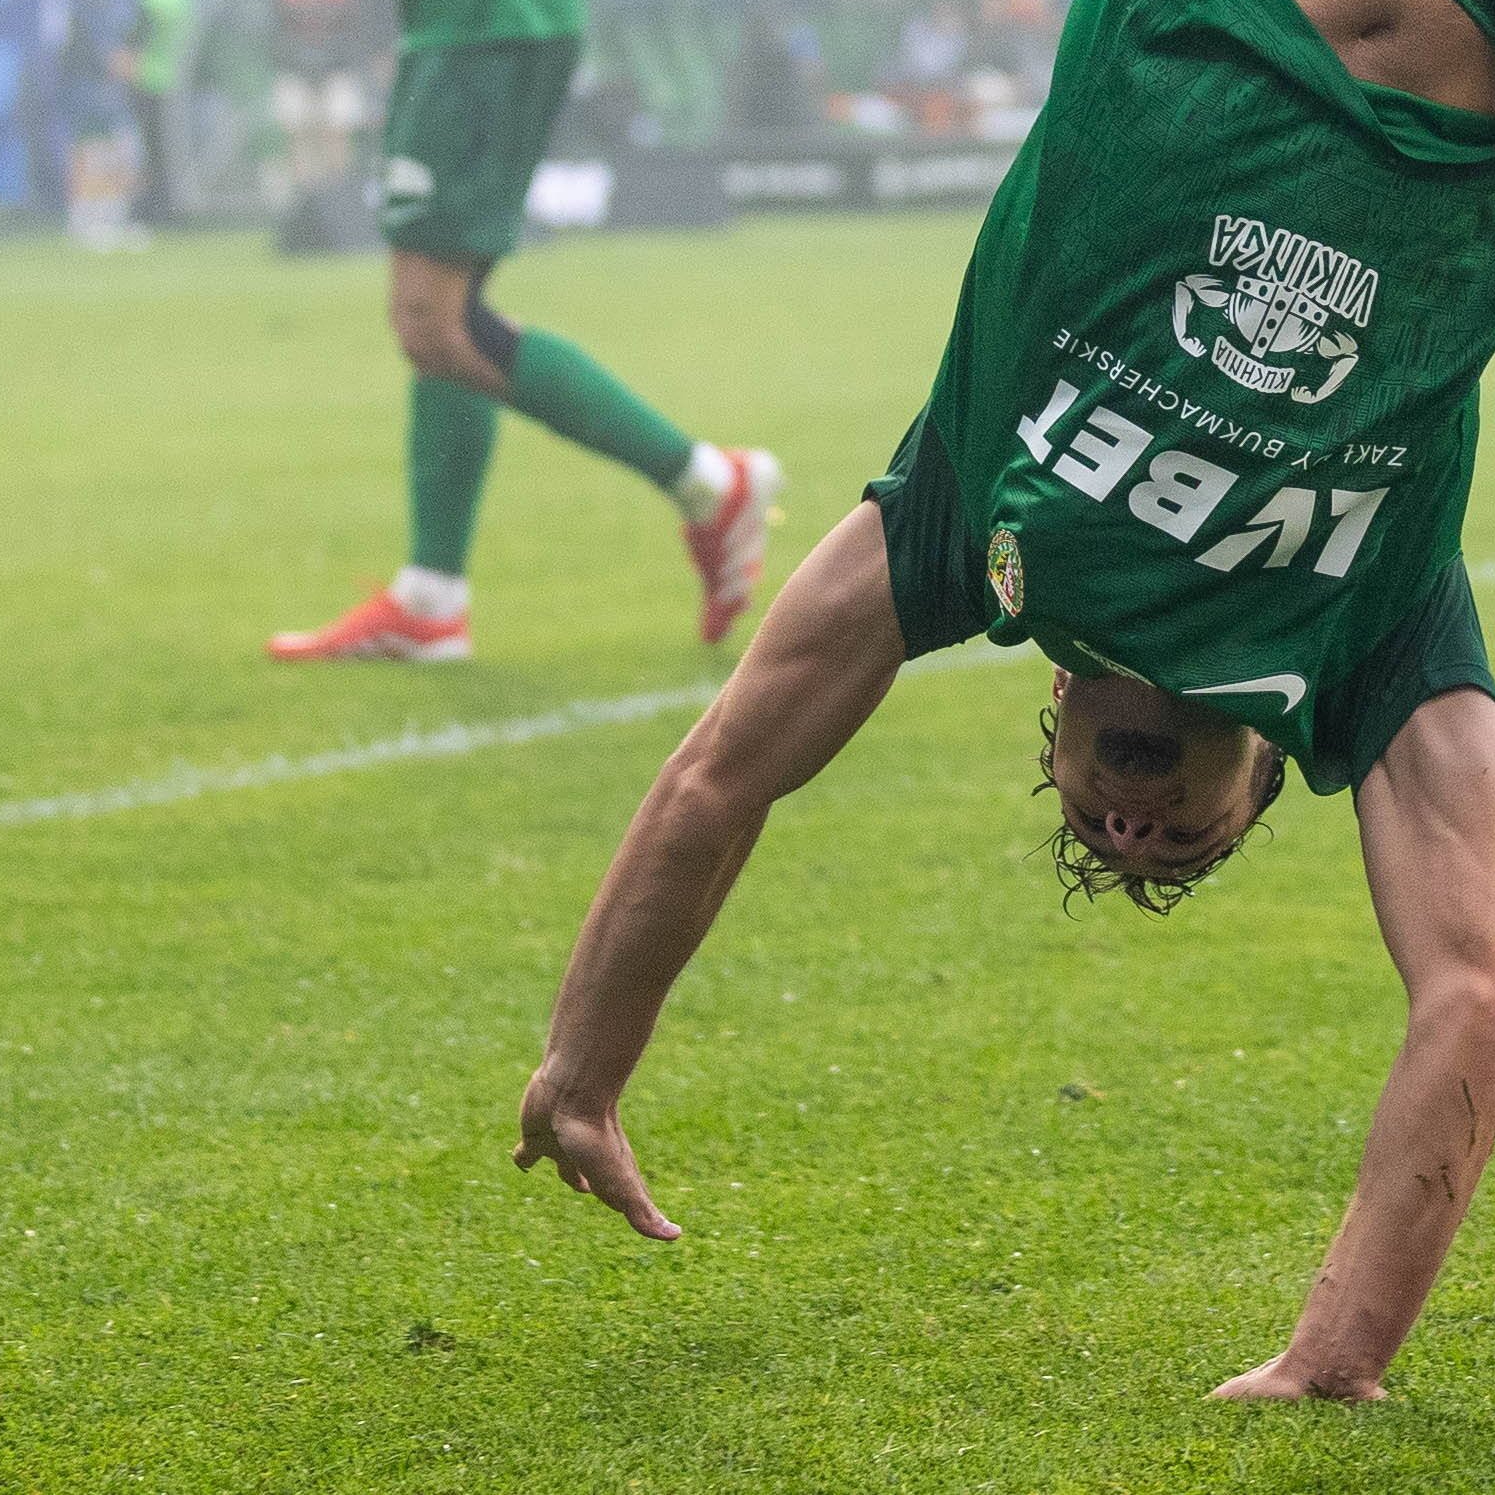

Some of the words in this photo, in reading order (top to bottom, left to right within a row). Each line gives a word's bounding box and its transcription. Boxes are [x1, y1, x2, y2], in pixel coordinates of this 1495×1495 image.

[1208, 214, 1379, 328] VIKINGA
[1051, 329, 1287, 459] BUKMACHERSKIE
[1214, 338, 1293, 390] KUCHNIA
[1290, 443, 1409, 471] ZAKŁY
